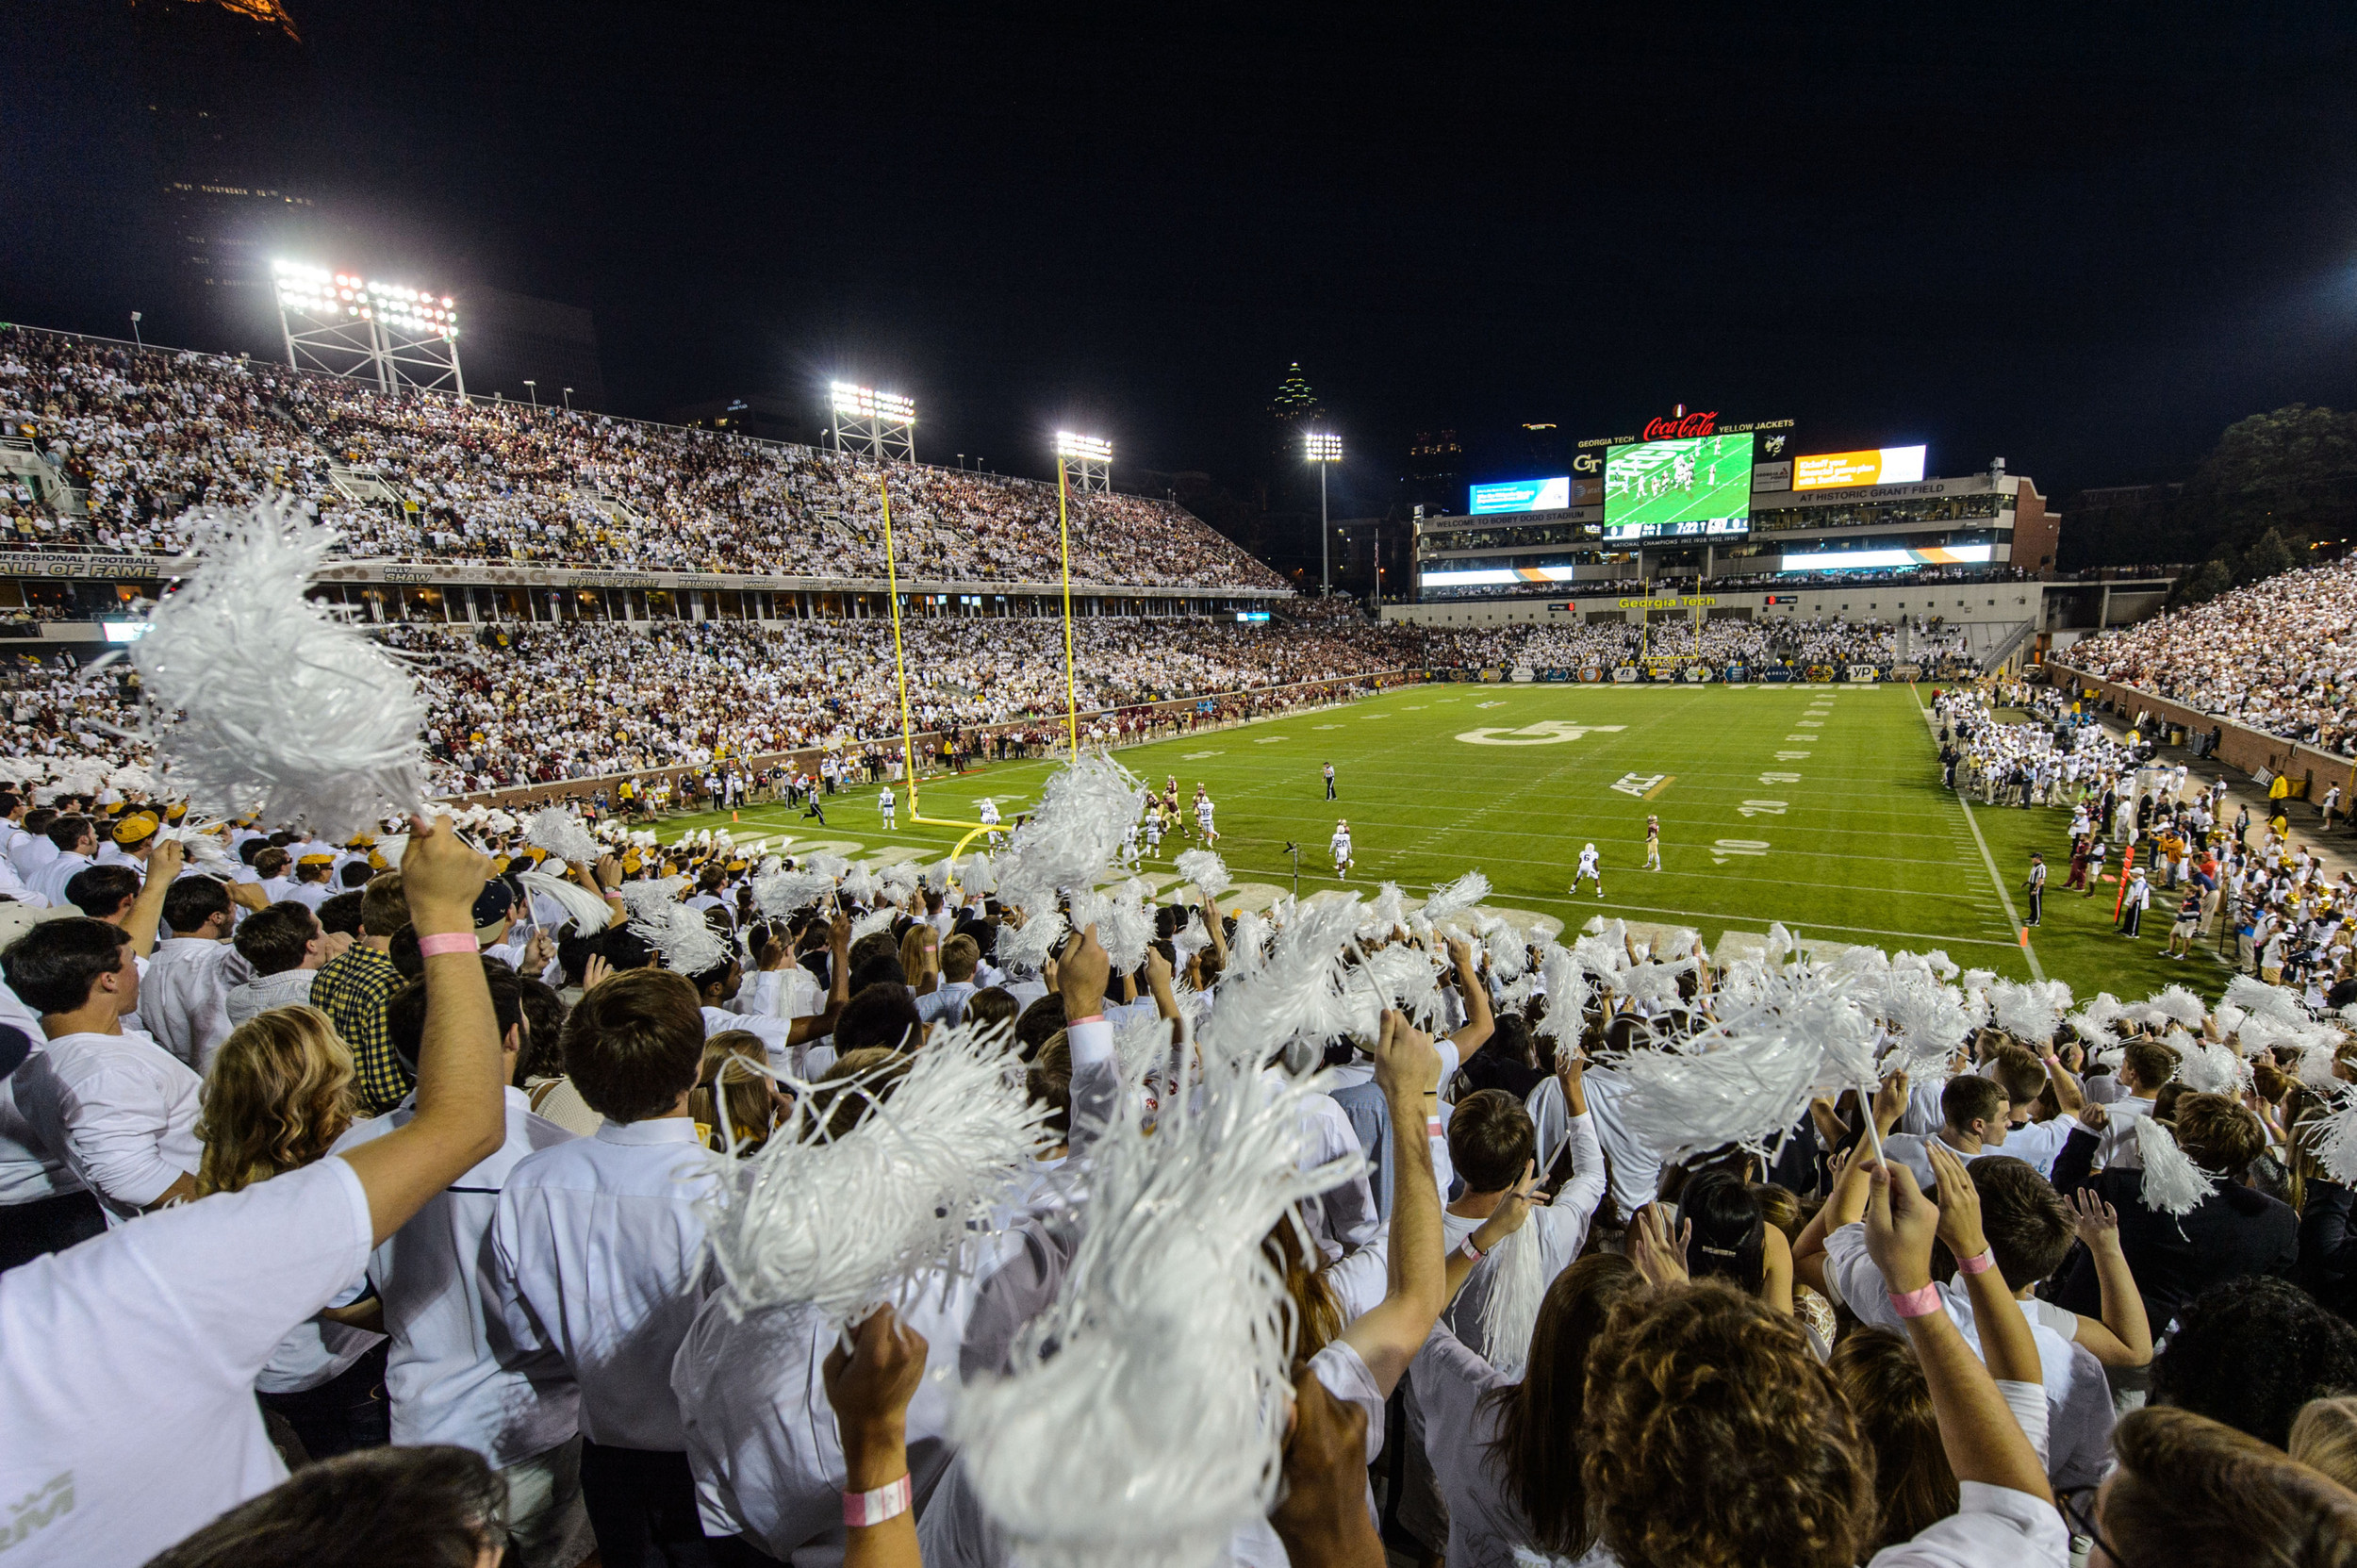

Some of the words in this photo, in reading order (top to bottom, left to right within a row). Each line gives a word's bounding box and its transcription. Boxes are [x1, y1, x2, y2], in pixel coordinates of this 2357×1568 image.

[1643, 411, 1719, 441] Coca-Cola
[1719, 423, 1754, 434] YELLOW
[1755, 419, 1794, 430] JACKETS
[1578, 437, 1612, 448] GEORGIA
[1614, 436, 1635, 445] TECH
[1574, 454, 1602, 472] GT
[1800, 494, 1814, 503] AT
[1816, 489, 1868, 502] HISTORIC
[1871, 487, 1908, 497] GRANT
[1911, 484, 1944, 494] FIELD
[1436, 520, 1475, 528] WELCOME
[1491, 516, 1518, 524] BOBBY
[1546, 511, 1585, 520] STADIUM
[91, 555, 158, 565] FOOTBALL
[48, 563, 85, 576] OF
[90, 565, 159, 578] FAME
[385, 573, 432, 582] SHAW
[568, 576, 601, 586] HALL
[603, 577, 621, 586] OF
[624, 578, 660, 587] FAME
[1619, 598, 1676, 609] Georgia
[1681, 596, 1716, 606] Tech
[1854, 667, 1871, 677] yp
[1758, 772, 1802, 783] 30
[1609, 772, 1666, 798] ACC
[1738, 801, 1788, 815] 20
[1336, 839, 1347, 848] 20
[1710, 839, 1771, 855] 10
